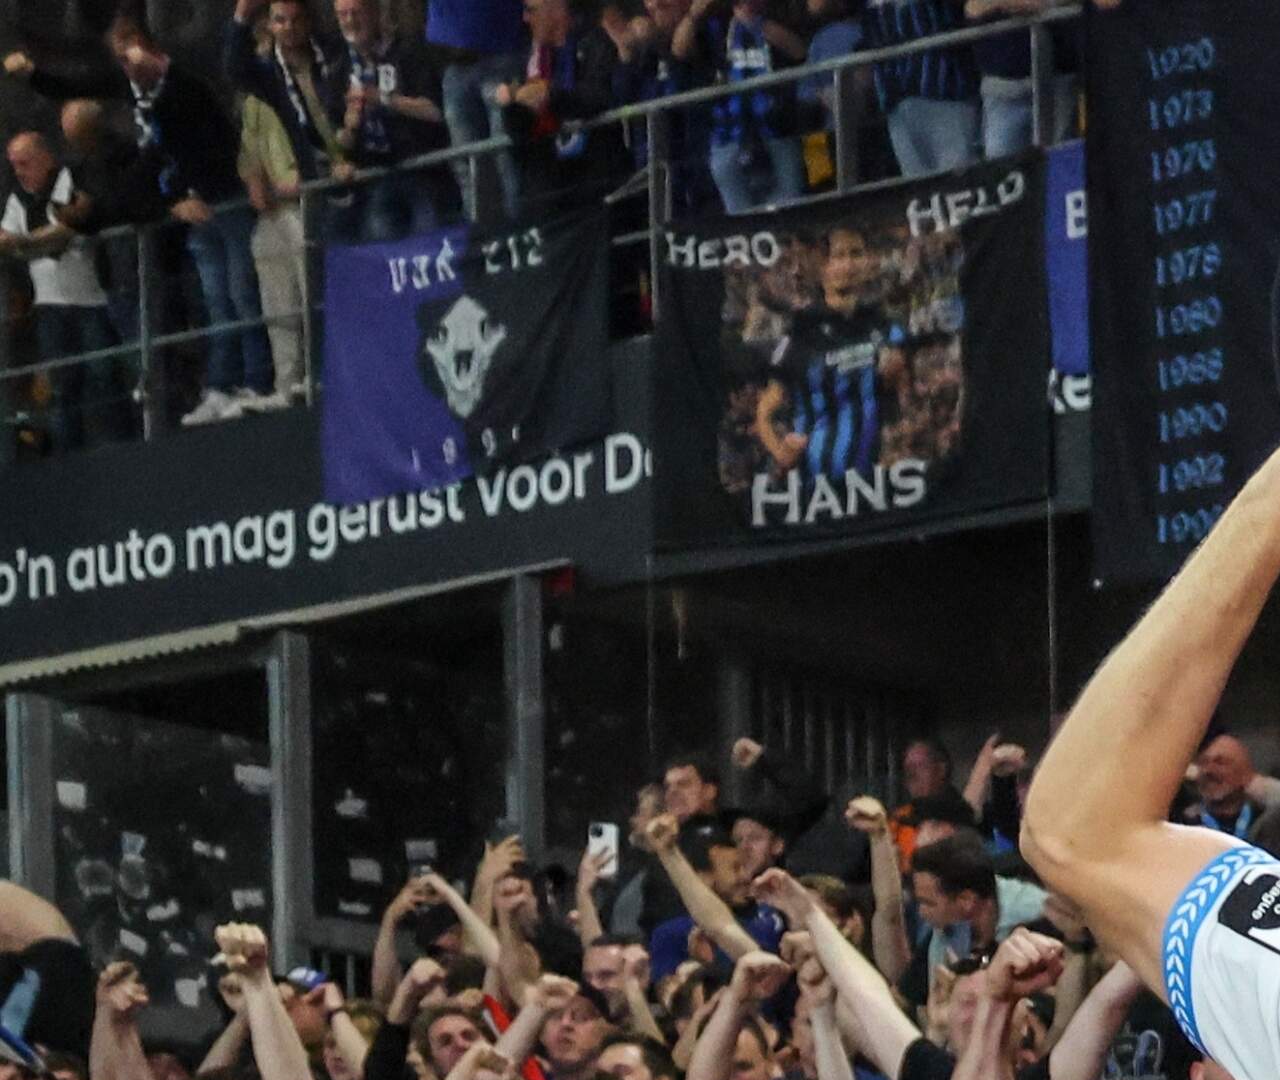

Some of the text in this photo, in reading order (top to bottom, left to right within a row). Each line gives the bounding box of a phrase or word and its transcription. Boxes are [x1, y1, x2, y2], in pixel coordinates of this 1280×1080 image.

[665, 230, 780, 269] HERO
[66, 528, 176, 592] auto
[186, 508, 296, 569] mag
[306, 481, 466, 561] gerust
[476, 450, 594, 518] voor
[604, 431, 653, 494] D
[750, 457, 929, 527] HANS
